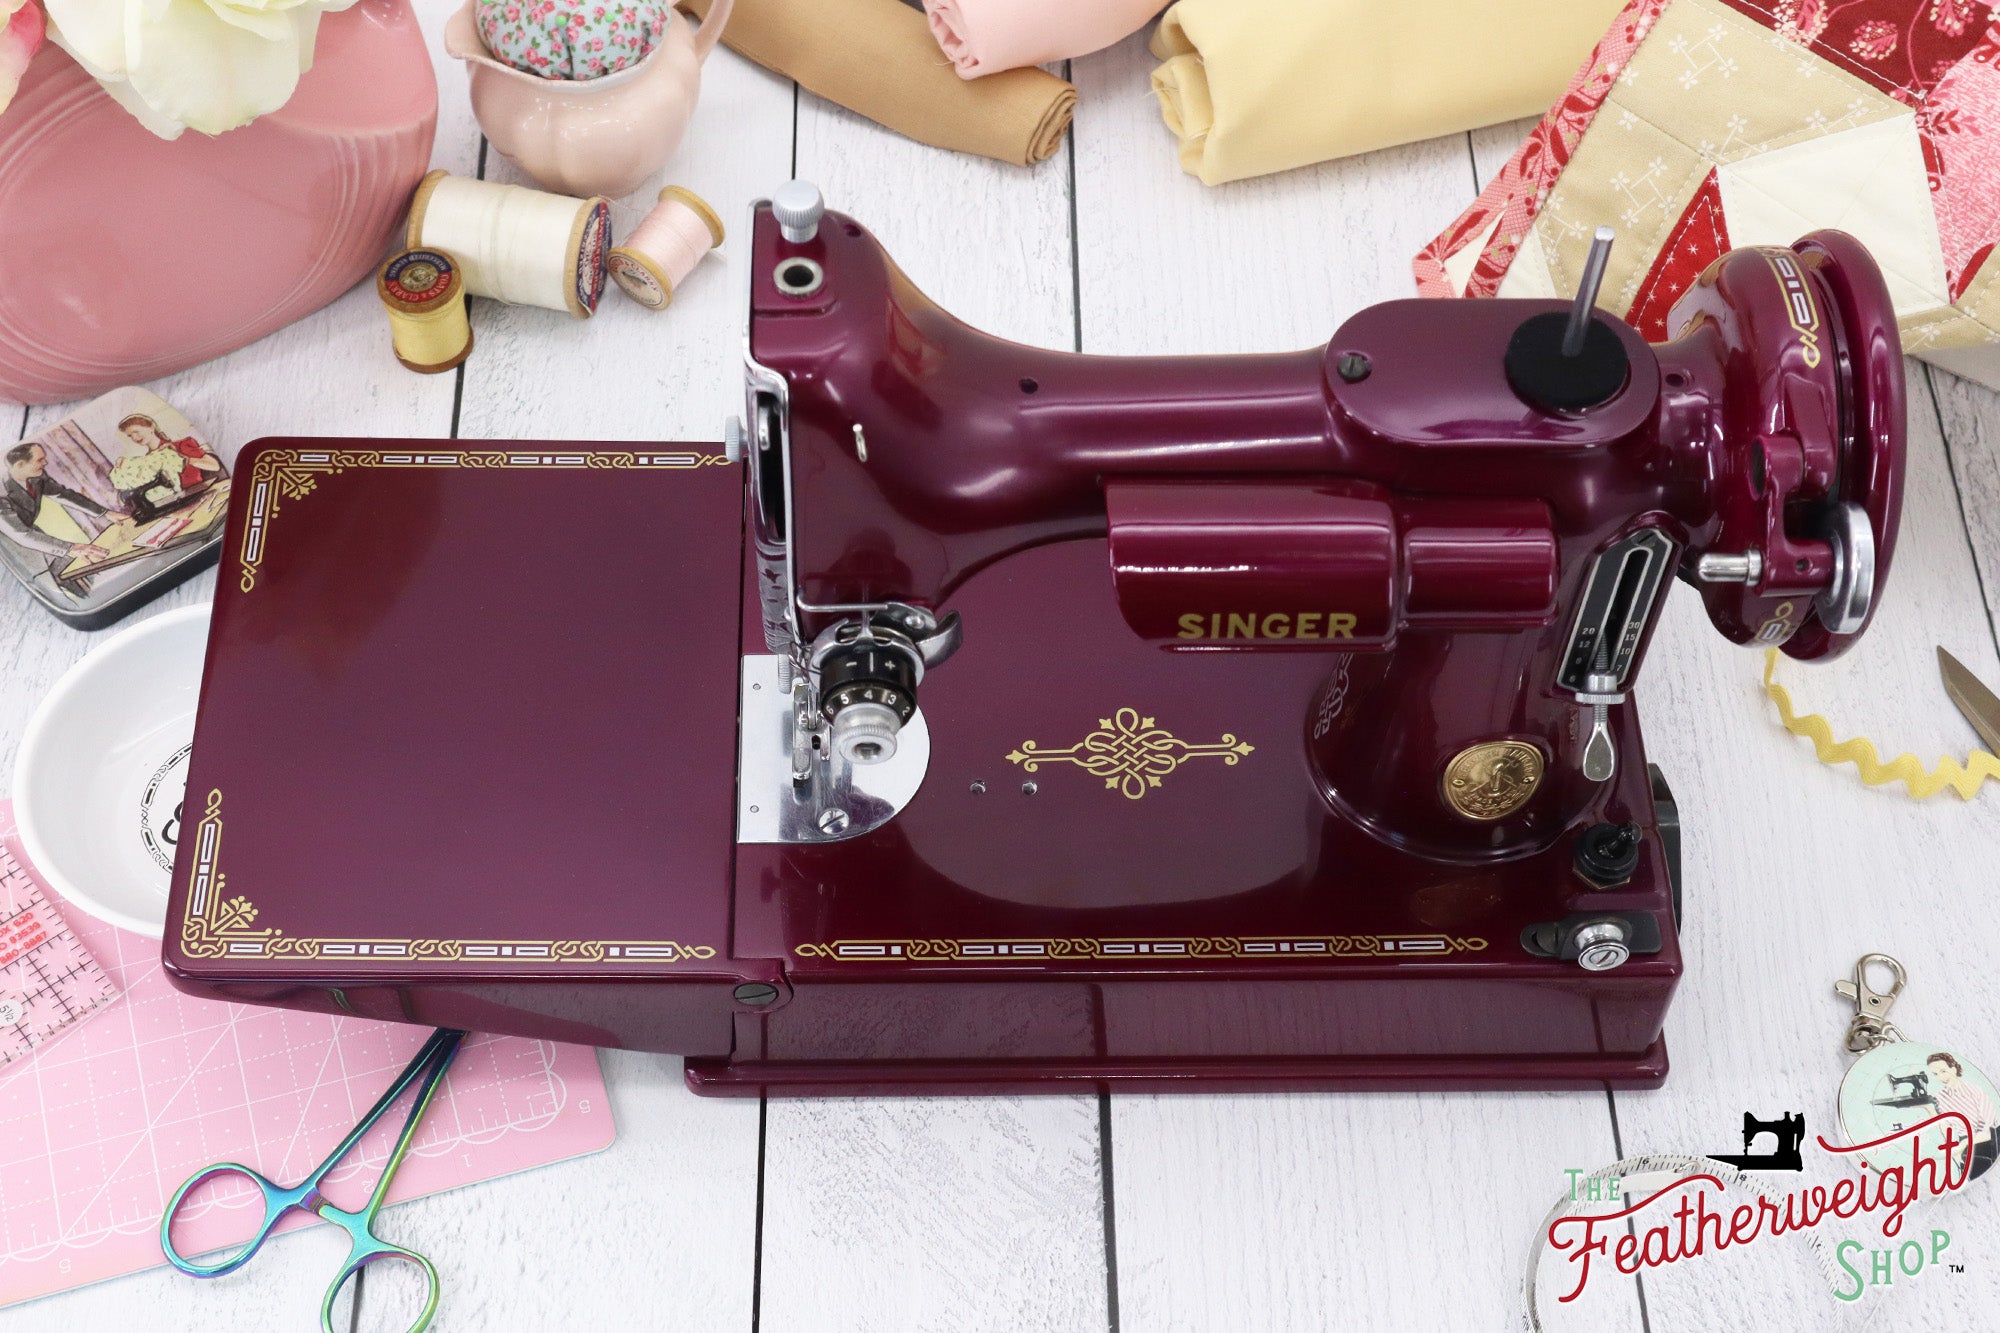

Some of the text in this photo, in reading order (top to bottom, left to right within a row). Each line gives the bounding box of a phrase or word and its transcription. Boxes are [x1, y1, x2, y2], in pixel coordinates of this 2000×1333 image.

[1177, 612, 1358, 639] SINGER
[1628, 621, 1640, 629] 30
[1578, 640, 1591, 648] 12
[1616, 664, 1622, 672] 7
[826, 690, 910, 716] 6 5 4 3 2
[579, 1100, 590, 1114] 5
[59, 1258, 72, 1274] 5
